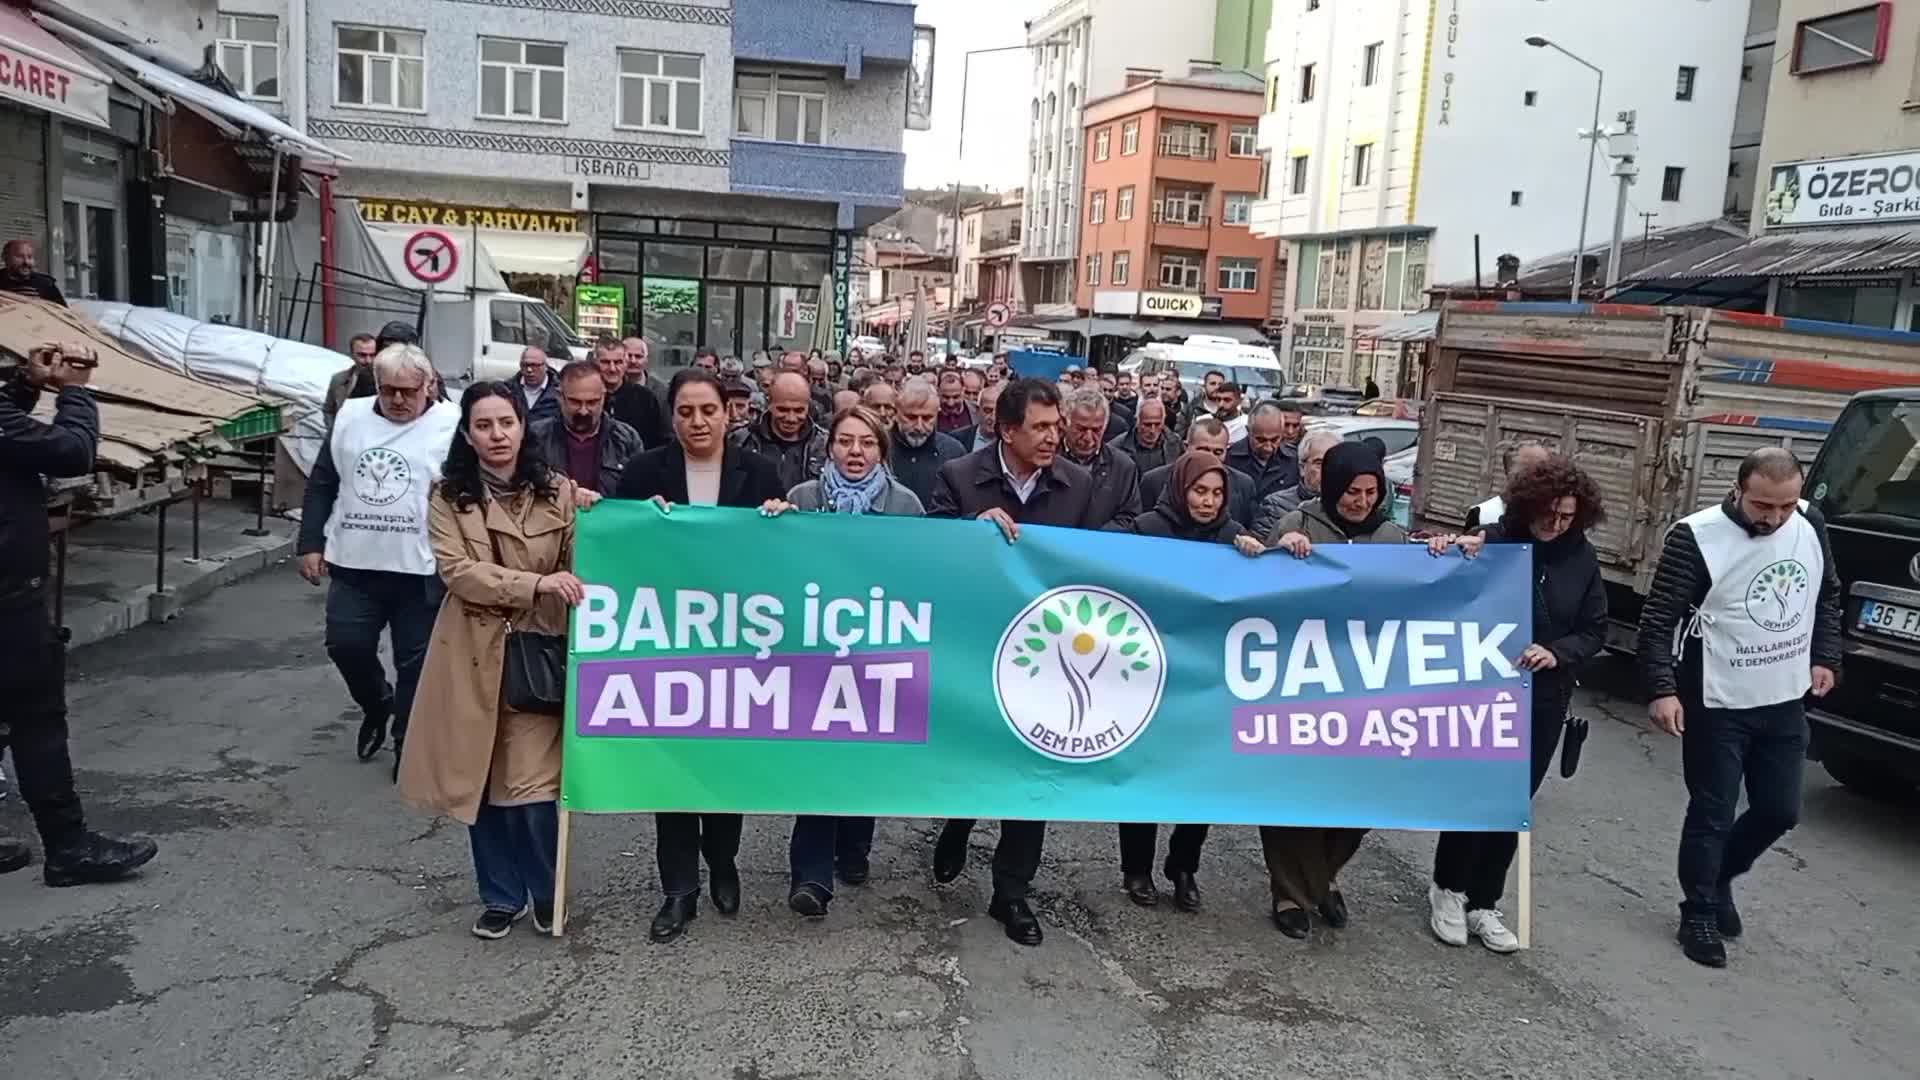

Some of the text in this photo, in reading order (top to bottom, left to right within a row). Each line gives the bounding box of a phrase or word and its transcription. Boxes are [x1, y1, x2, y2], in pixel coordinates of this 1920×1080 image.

[1808, 166, 1920, 200] ÖZERO
[442, 209, 459, 225] &
[1146, 296, 1189, 311] QUICK
[575, 582, 932, 660] BARIŞ İÇİN
[1871, 605, 1896, 626] 36
[1224, 617, 1521, 701] GAVEK
[1730, 658, 1744, 668] VE
[1736, 640, 1792, 655] HALKLARIN
[588, 662, 913, 734] ADIM AT
[1030, 720, 1124, 752] DEM PARTİ
[1237, 692, 1519, 758] JI BO AŞTIYÊ
